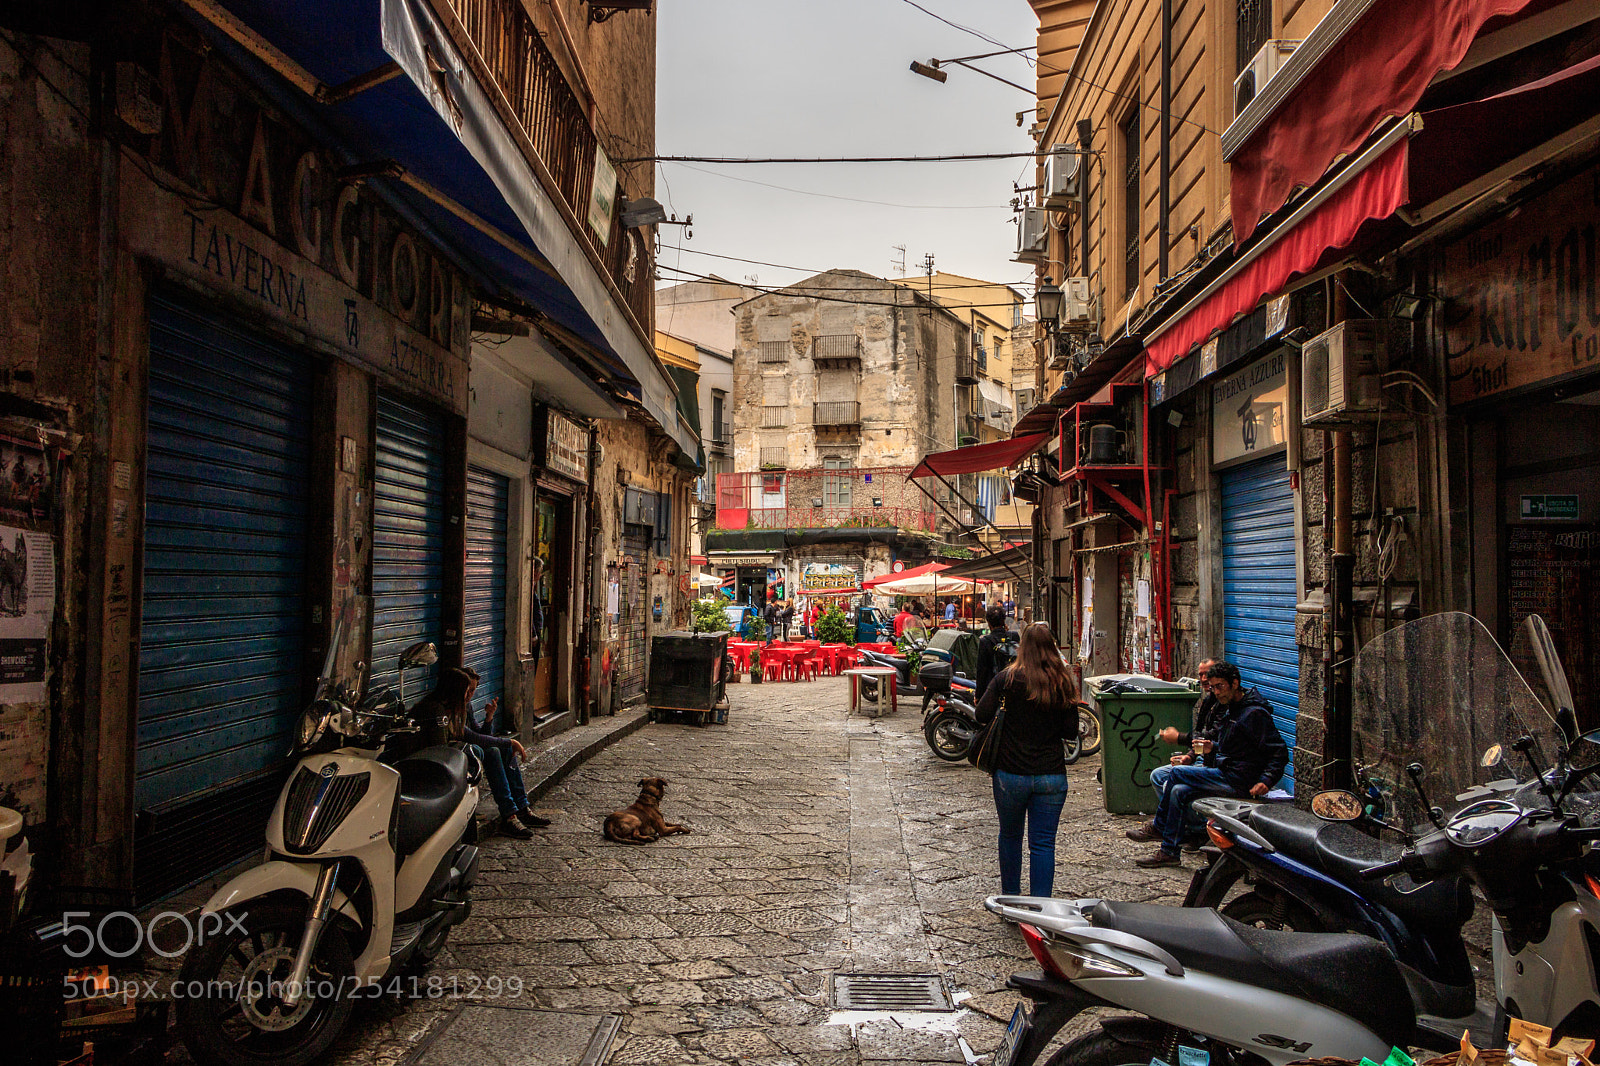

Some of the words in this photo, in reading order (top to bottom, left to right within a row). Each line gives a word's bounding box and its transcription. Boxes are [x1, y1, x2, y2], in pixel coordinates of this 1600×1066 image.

[183, 209, 309, 322] TAVERNA
[388, 334, 454, 398] AZZURRA
[1214, 376, 1247, 404] TAVERNA
